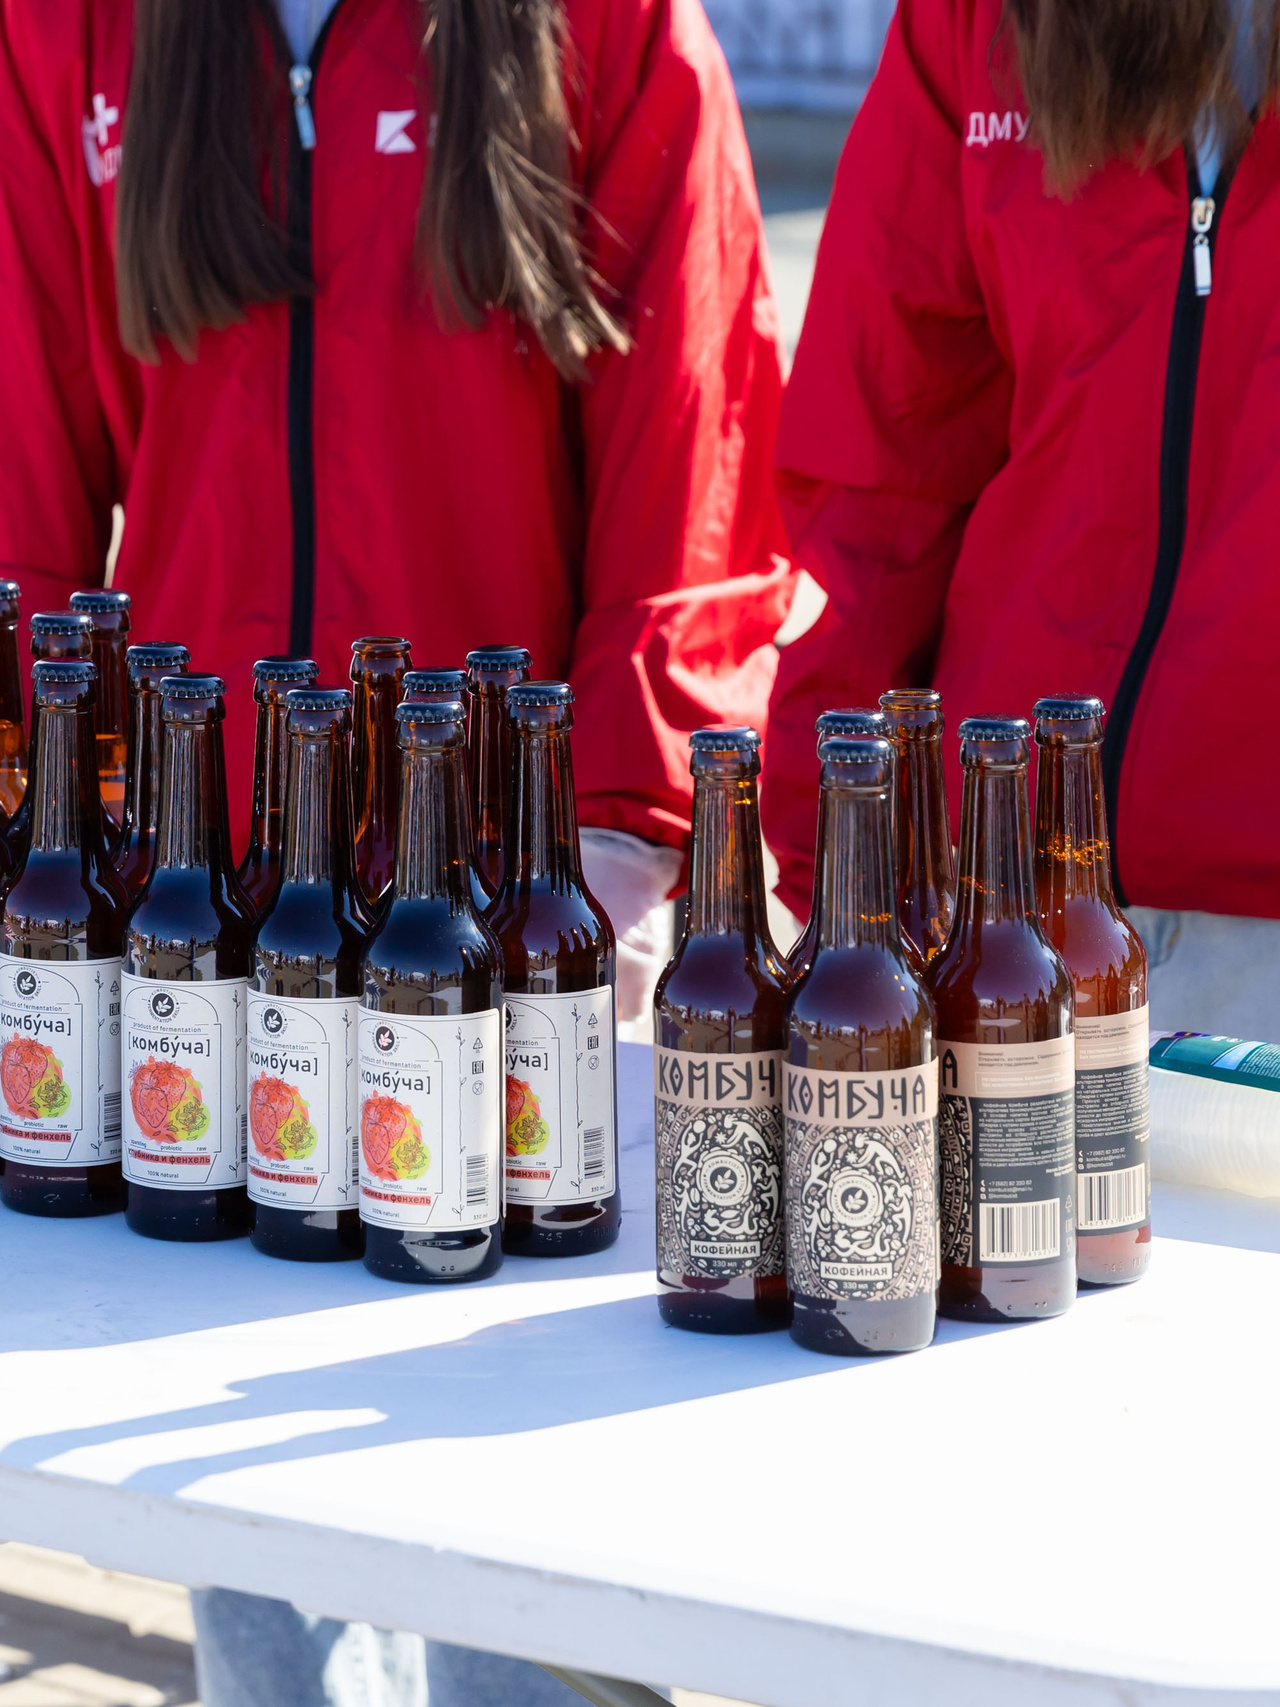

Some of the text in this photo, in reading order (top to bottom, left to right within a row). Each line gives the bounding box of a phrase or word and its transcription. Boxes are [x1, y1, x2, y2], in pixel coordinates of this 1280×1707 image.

[23, 1003, 62, 1012] fermentation
[133, 1022, 152, 1030] product
[270, 1041, 308, 1050] fermentation
[382, 1060, 421, 1069] fermentation
[659, 1053, 775, 1101] КОМБУЧ
[788, 1071, 926, 1119] КОМБУЧА
[31, 1130, 71, 1141] фенхель
[23, 1146, 40, 1154] natural
[169, 1154, 211, 1165] фенхель
[160, 1171, 179, 1179] natural
[510, 1168, 551, 1179] фенхель
[277, 1173, 318, 1184] фенхель
[383, 1182, 403, 1190] probiotic
[270, 1189, 287, 1197] natural
[390, 1193, 431, 1204] фенхель
[383, 1210, 399, 1218] natural
[693, 1243, 757, 1255] КОФЕЙНАЯ
[712, 1260, 726, 1268] 330
[824, 1264, 889, 1277] КОФЕЙНАЯ
[842, 1281, 856, 1290] 330
